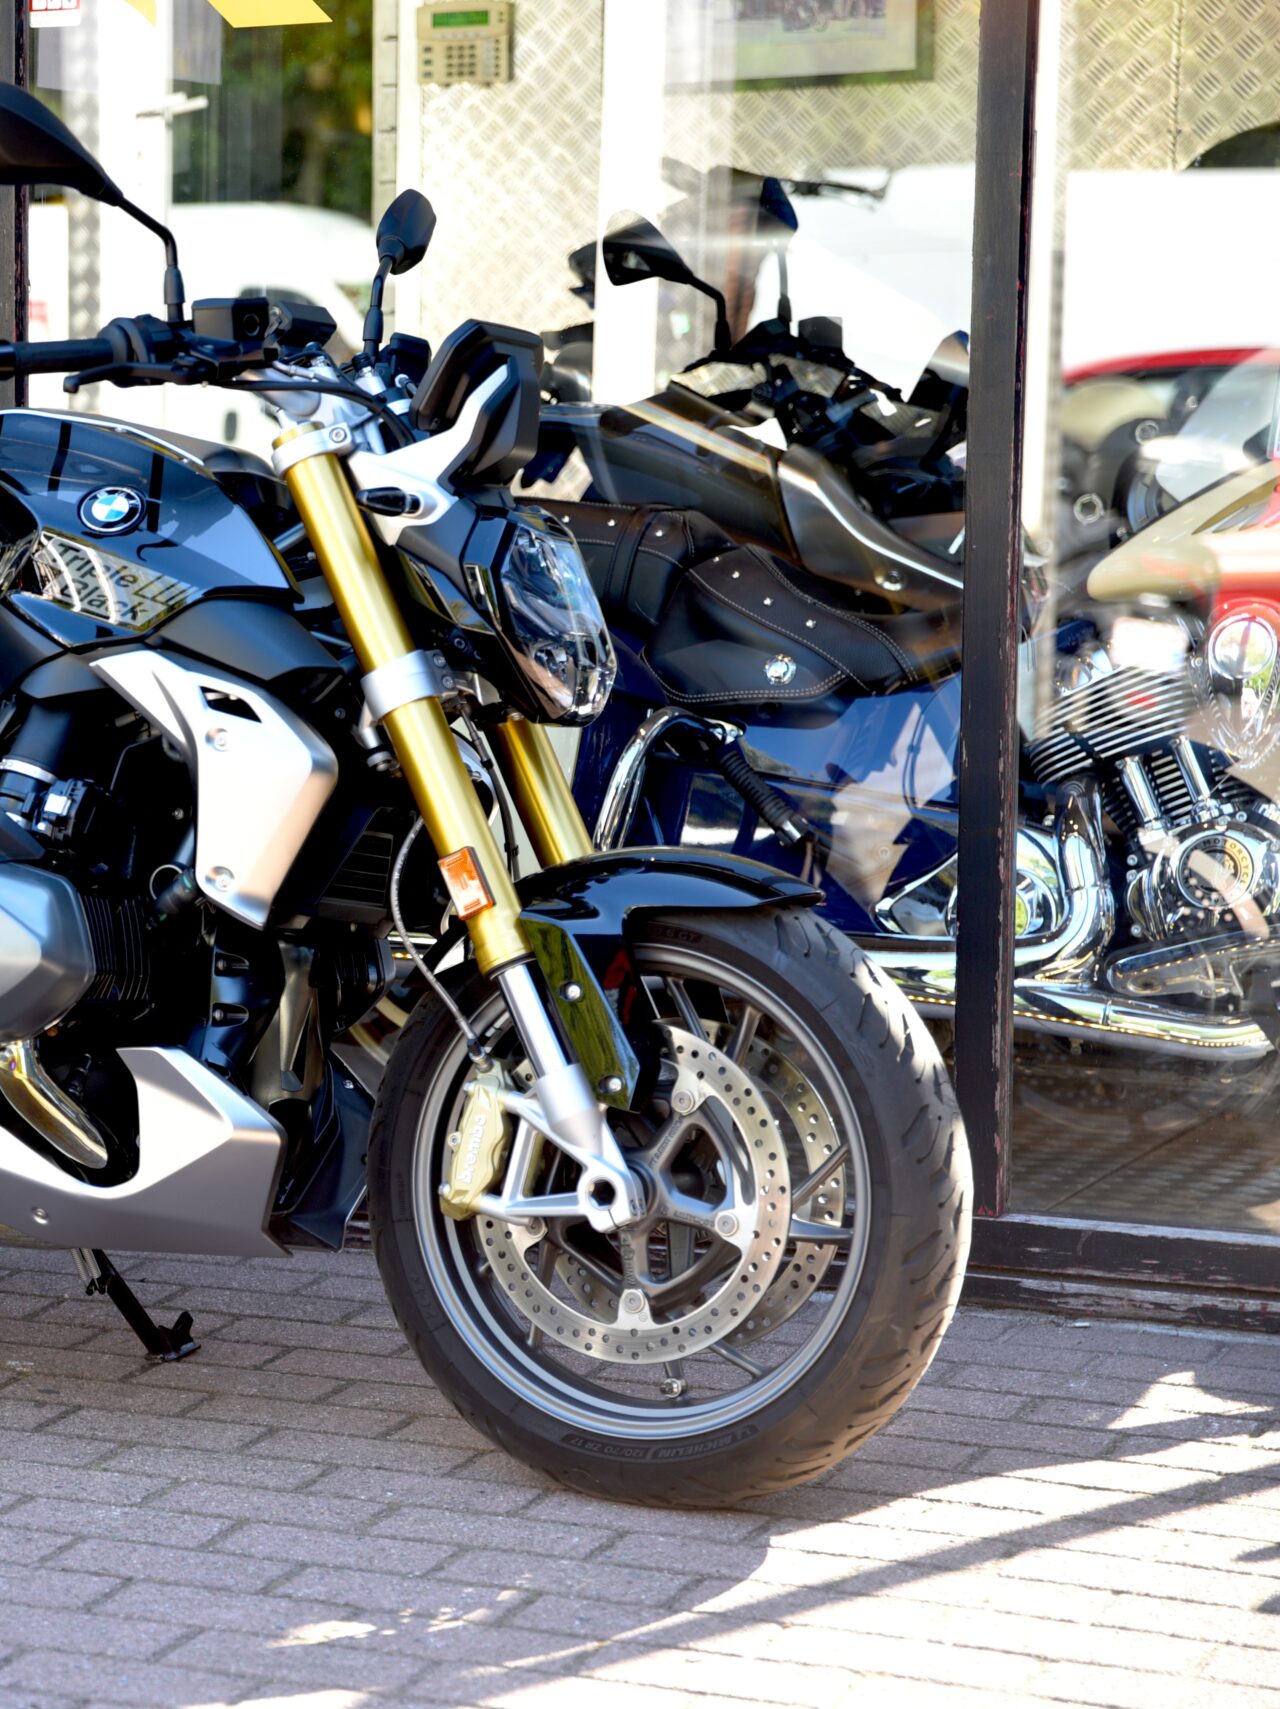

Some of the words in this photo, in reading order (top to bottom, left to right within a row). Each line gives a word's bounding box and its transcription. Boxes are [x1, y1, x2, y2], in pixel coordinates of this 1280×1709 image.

[58, 543, 139, 588] Triple
[1202, 836, 1249, 886] MOTORCYCL
[459, 1114, 487, 1184] brembo
[584, 1440, 603, 1451] ZR
[604, 1445, 644, 1457] 120/70
[656, 1434, 732, 1458] MICHELIN
